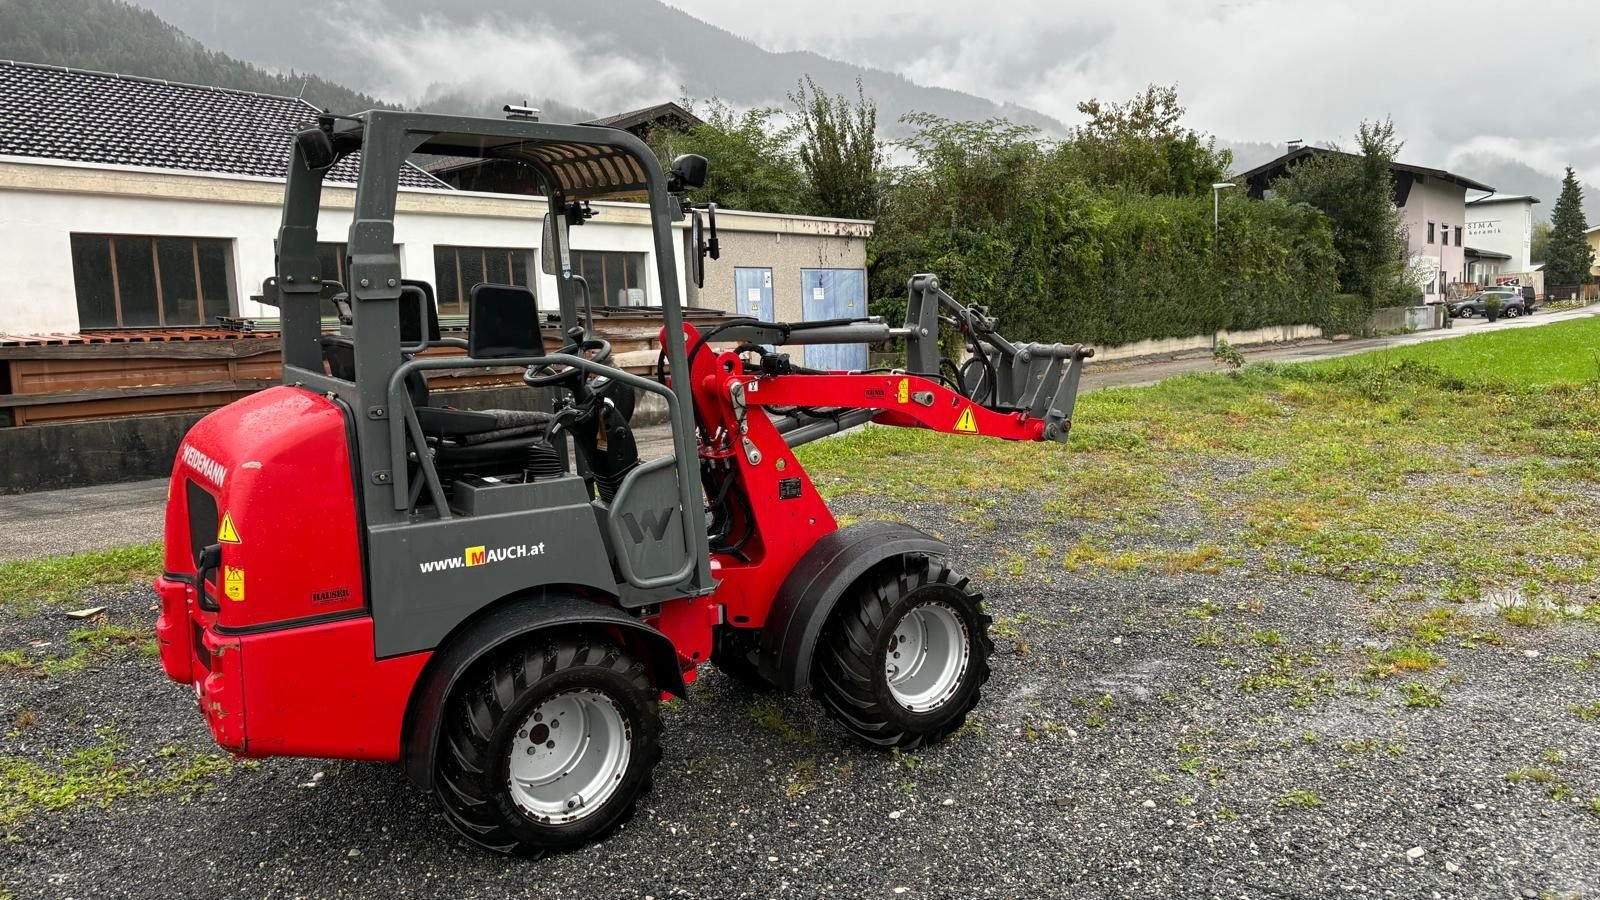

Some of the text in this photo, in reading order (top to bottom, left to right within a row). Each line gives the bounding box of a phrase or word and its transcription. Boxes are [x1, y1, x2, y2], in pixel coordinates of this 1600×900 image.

[1467, 221, 1493, 229] SIMA
[181, 442, 228, 488] WEIDEMANN
[420, 541, 545, 573] www.MAUCH.at
